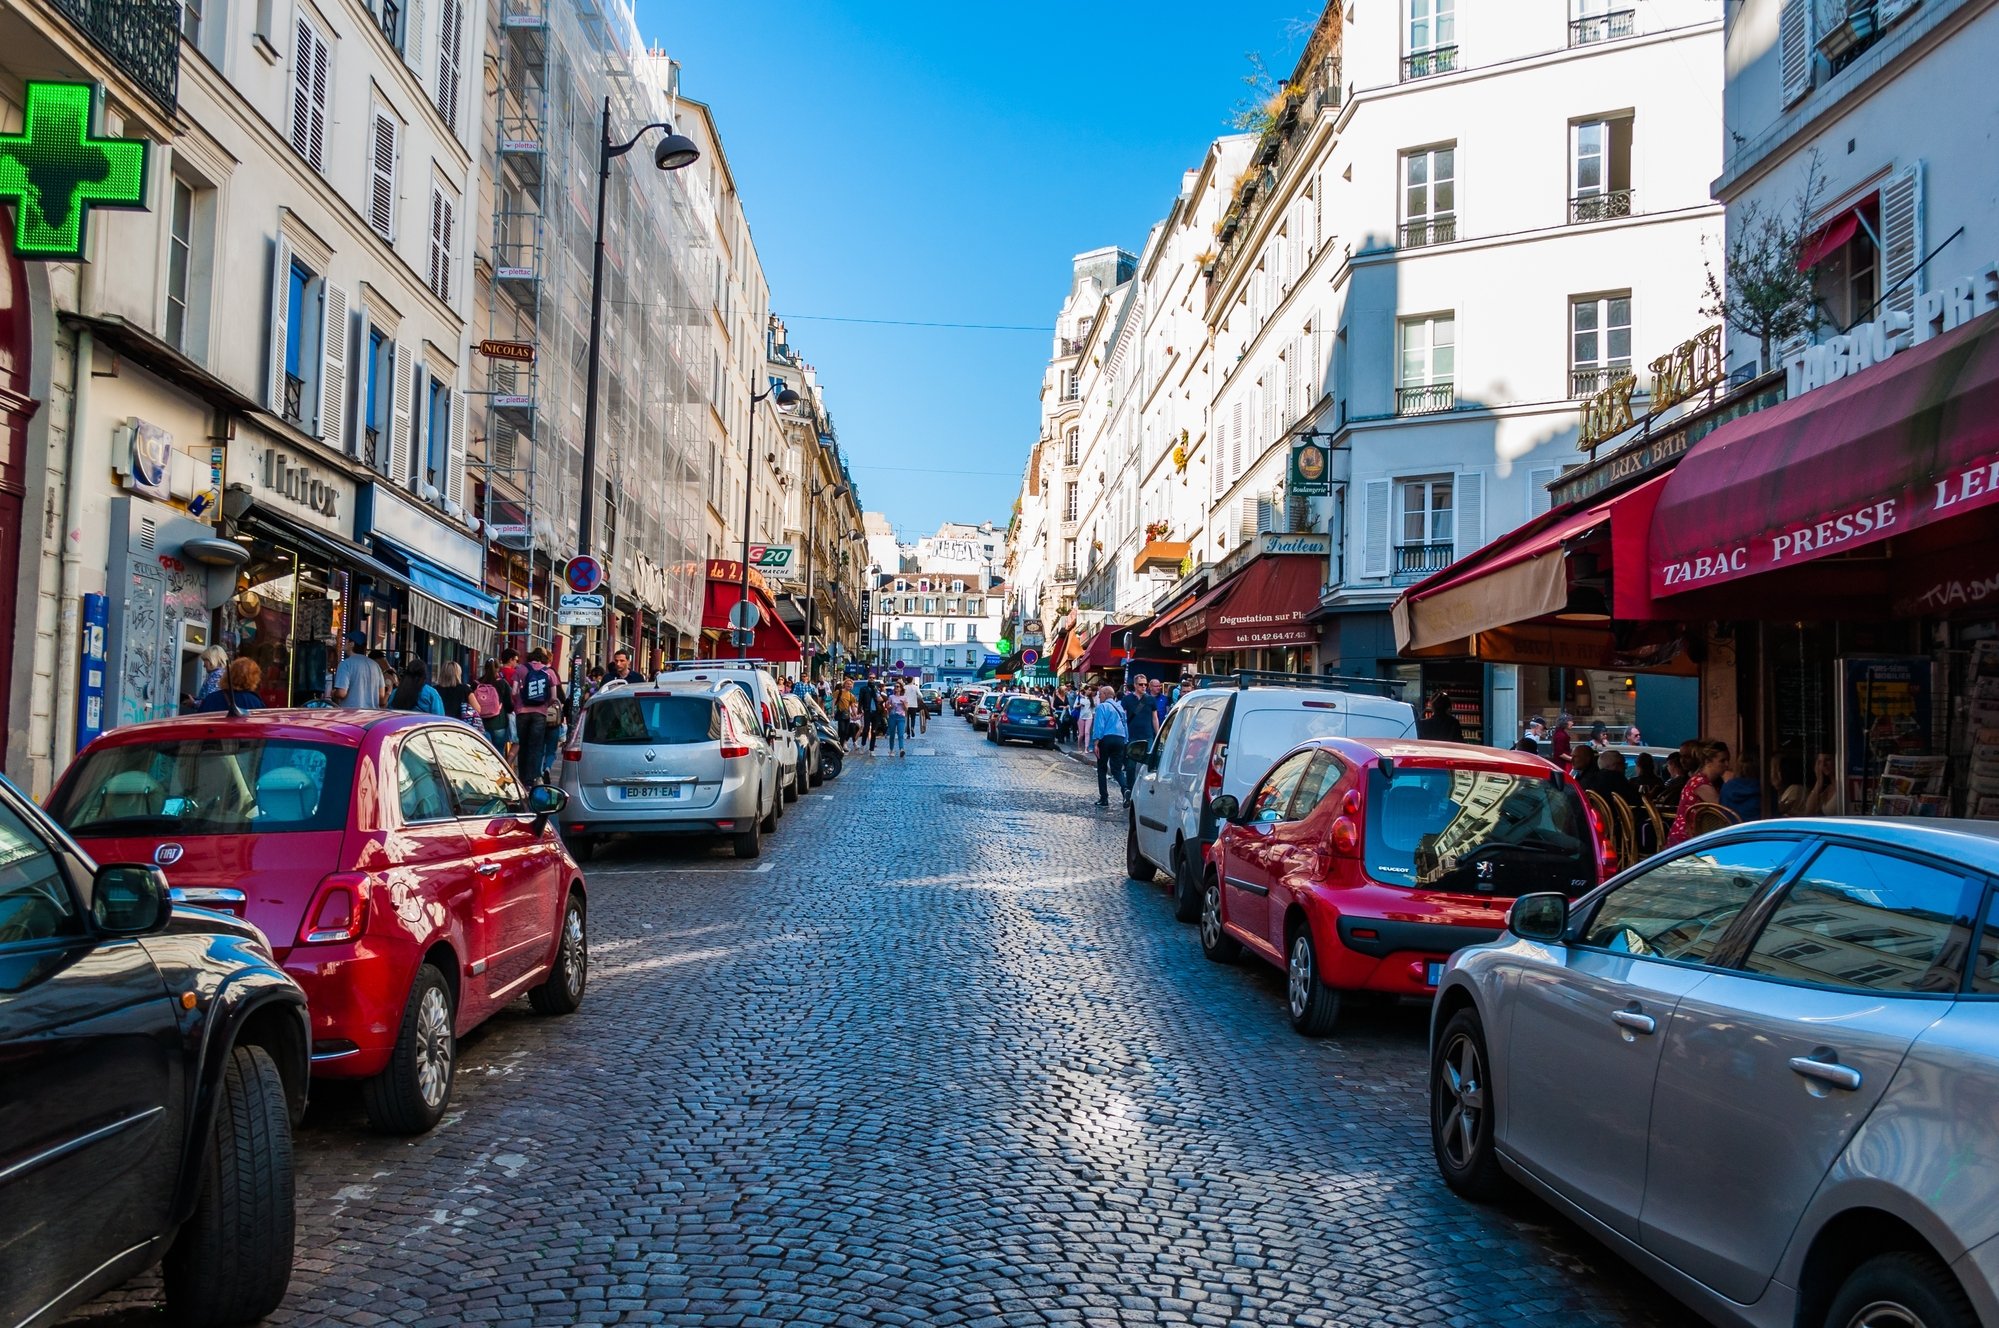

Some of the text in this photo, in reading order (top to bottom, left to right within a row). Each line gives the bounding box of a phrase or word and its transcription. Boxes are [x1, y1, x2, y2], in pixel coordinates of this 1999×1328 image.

[514, 141, 538, 150] plettac
[508, 267, 531, 276] plettac
[484, 343, 529, 357] NICOLAS
[1782, 311, 1911, 400] TABAC
[1576, 324, 1725, 452] LUX BAR
[506, 396, 529, 404] plettac
[1610, 430, 1688, 482] LUX BAR
[1292, 486, 1327, 494] Boulangerie
[1267, 535, 1325, 552] Traiteur
[1663, 498, 1897, 586] TABAC PRESSE
[749, 548, 788, 562] G20
[710, 562, 725, 578] des
[729, 562, 737, 579] 2
[1220, 613, 1272, 626] Dégustation
[528, 679, 546, 696] EF
[159, 848, 178, 859] FIAT
[1378, 865, 1410, 873] PEUGEOT
[1571, 879, 1587, 887] 107
